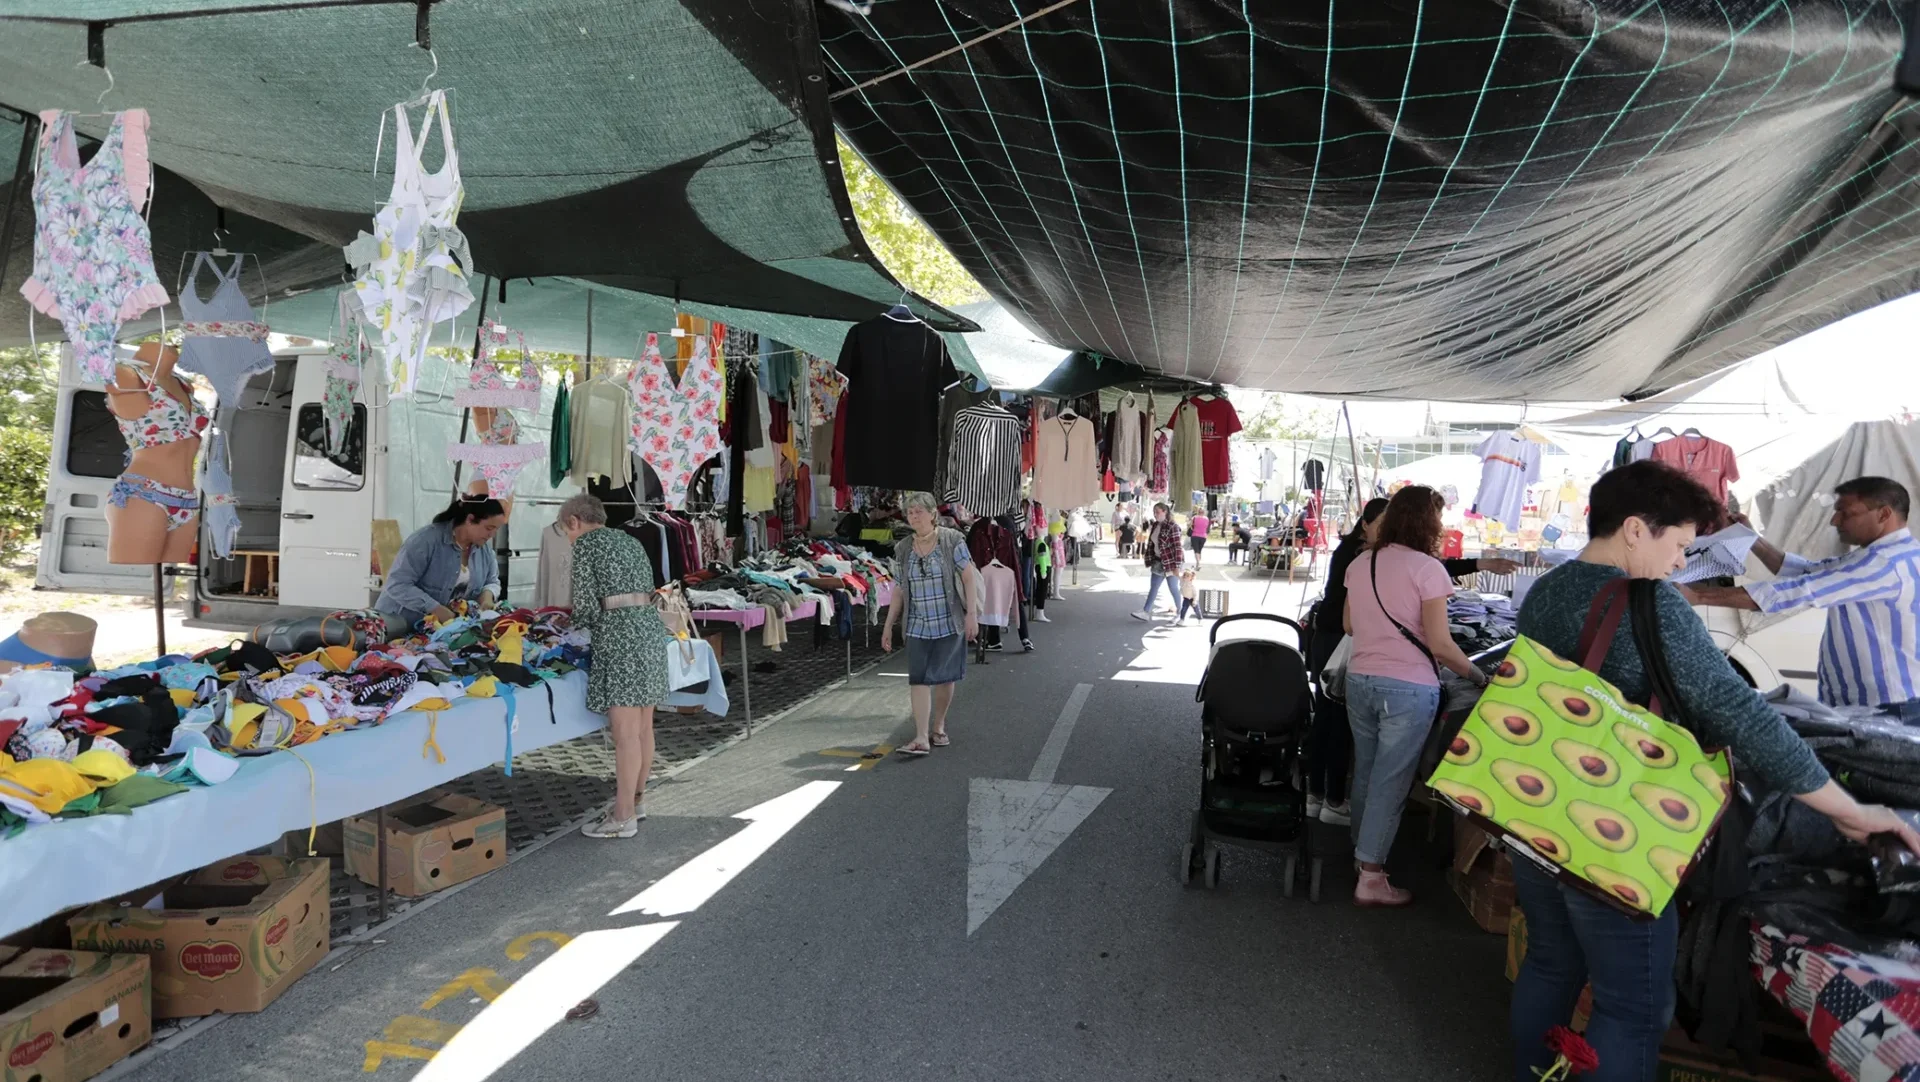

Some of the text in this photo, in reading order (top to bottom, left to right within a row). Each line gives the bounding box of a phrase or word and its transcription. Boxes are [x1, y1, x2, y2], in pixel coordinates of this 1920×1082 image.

[76, 937, 165, 951] BANANAS
[184, 952, 240, 963] Del Monte
